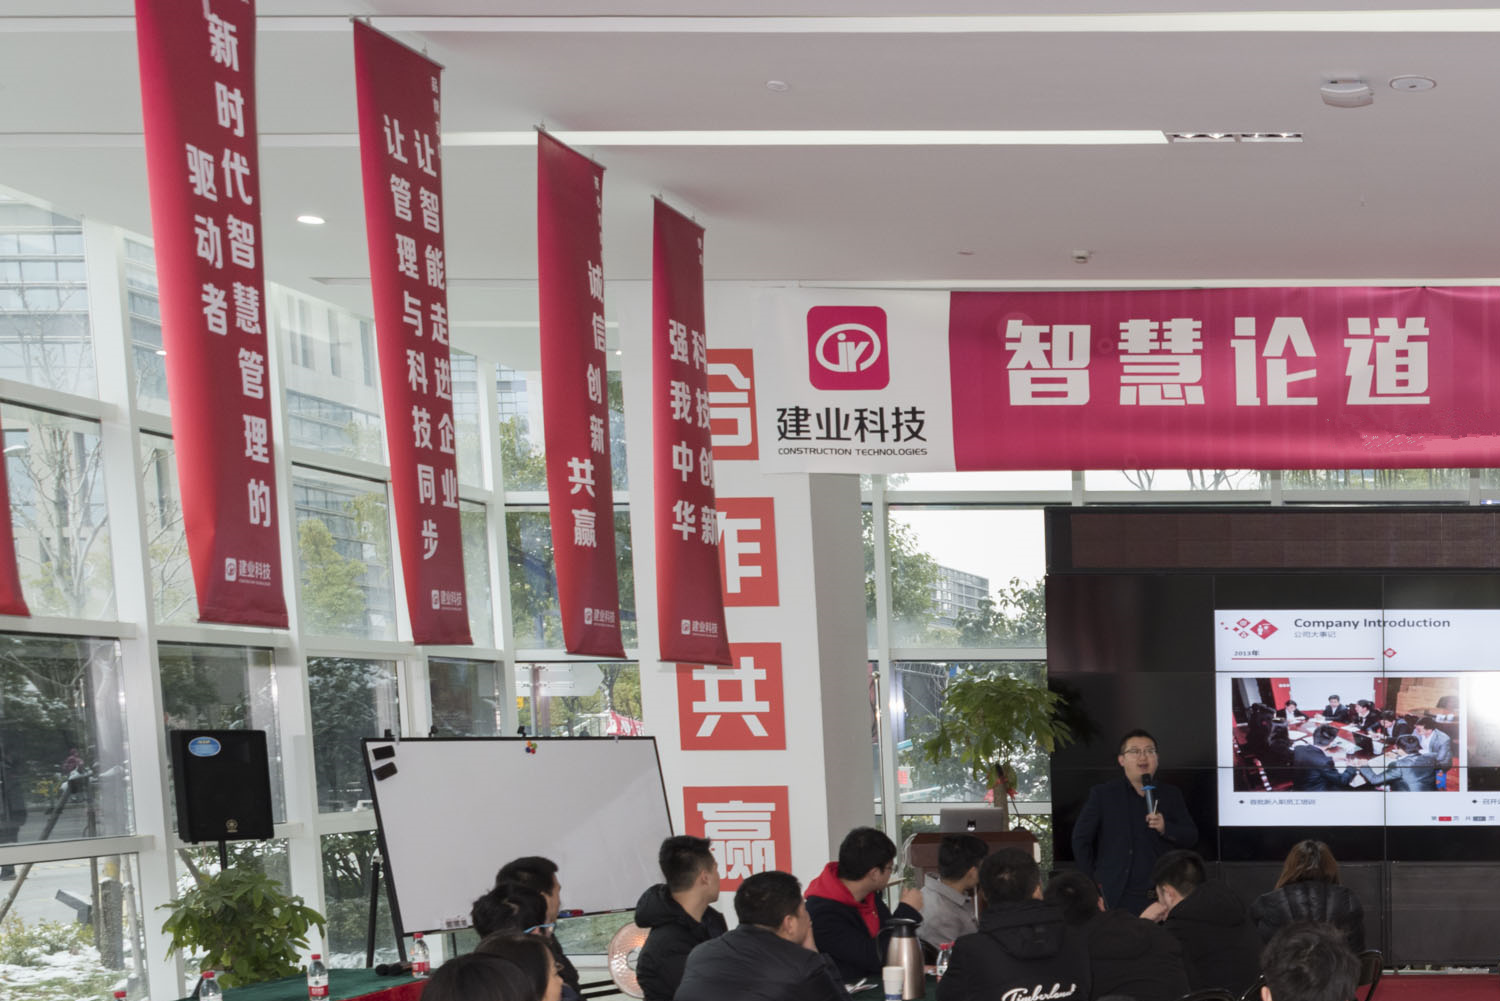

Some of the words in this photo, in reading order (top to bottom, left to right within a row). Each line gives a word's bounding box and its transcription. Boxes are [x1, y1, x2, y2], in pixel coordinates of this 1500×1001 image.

[185, 142, 228, 337] 驱动者
[207, 15, 271, 528] 新时代智慧管理的
[383, 114, 438, 561] 让管理与科技同步
[413, 129, 458, 509] 让智能走进企业
[1005, 316, 1430, 406] 智慧论道
[668, 319, 696, 541] 强我中华
[776, 405, 927, 443] 建业科技
[778, 447, 852, 456] CONSTRUCTION
[856, 448, 928, 457] TECHNOLOGIES
[239, 558, 271, 580] 建业科技
[1294, 618, 1360, 630] Company
[1363, 618, 1451, 628] Introduction
